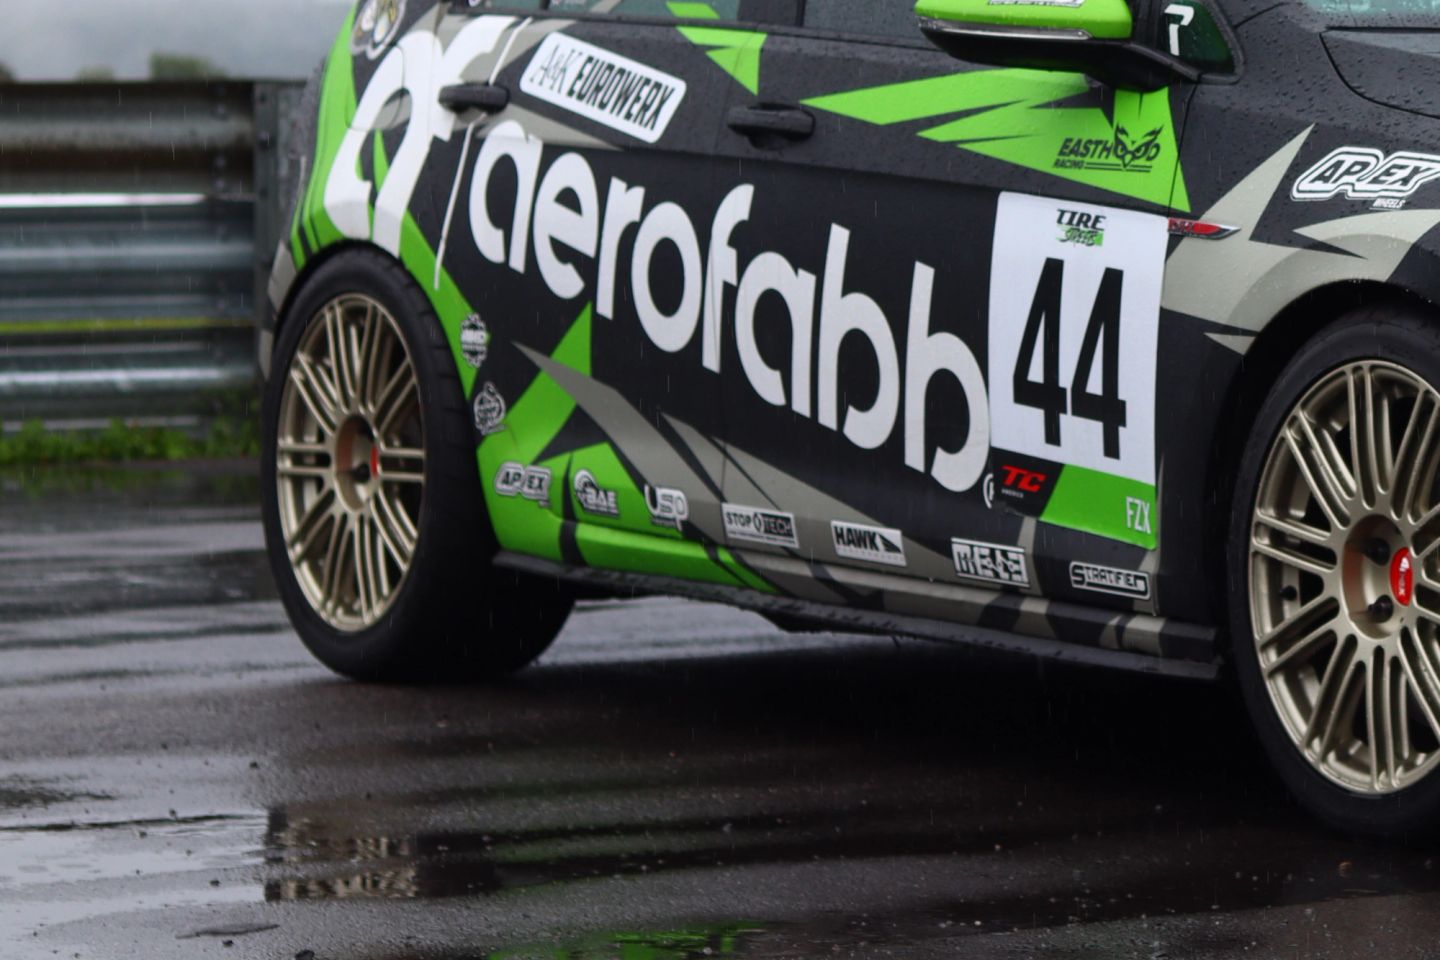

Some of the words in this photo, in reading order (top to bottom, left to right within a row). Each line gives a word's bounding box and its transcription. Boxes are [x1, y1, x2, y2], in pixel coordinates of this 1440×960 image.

[567, 56, 676, 132] EUROWERX
[1057, 209, 1106, 231] TIRE
[469, 120, 989, 495] aerofabb
[1013, 257, 1127, 460] 44
[1002, 464, 1046, 492] TC
[726, 511, 752, 527] STOP
[763, 515, 793, 536] TECH
[1126, 496, 1151, 534] FZX
[833, 525, 880, 552] HAWK
